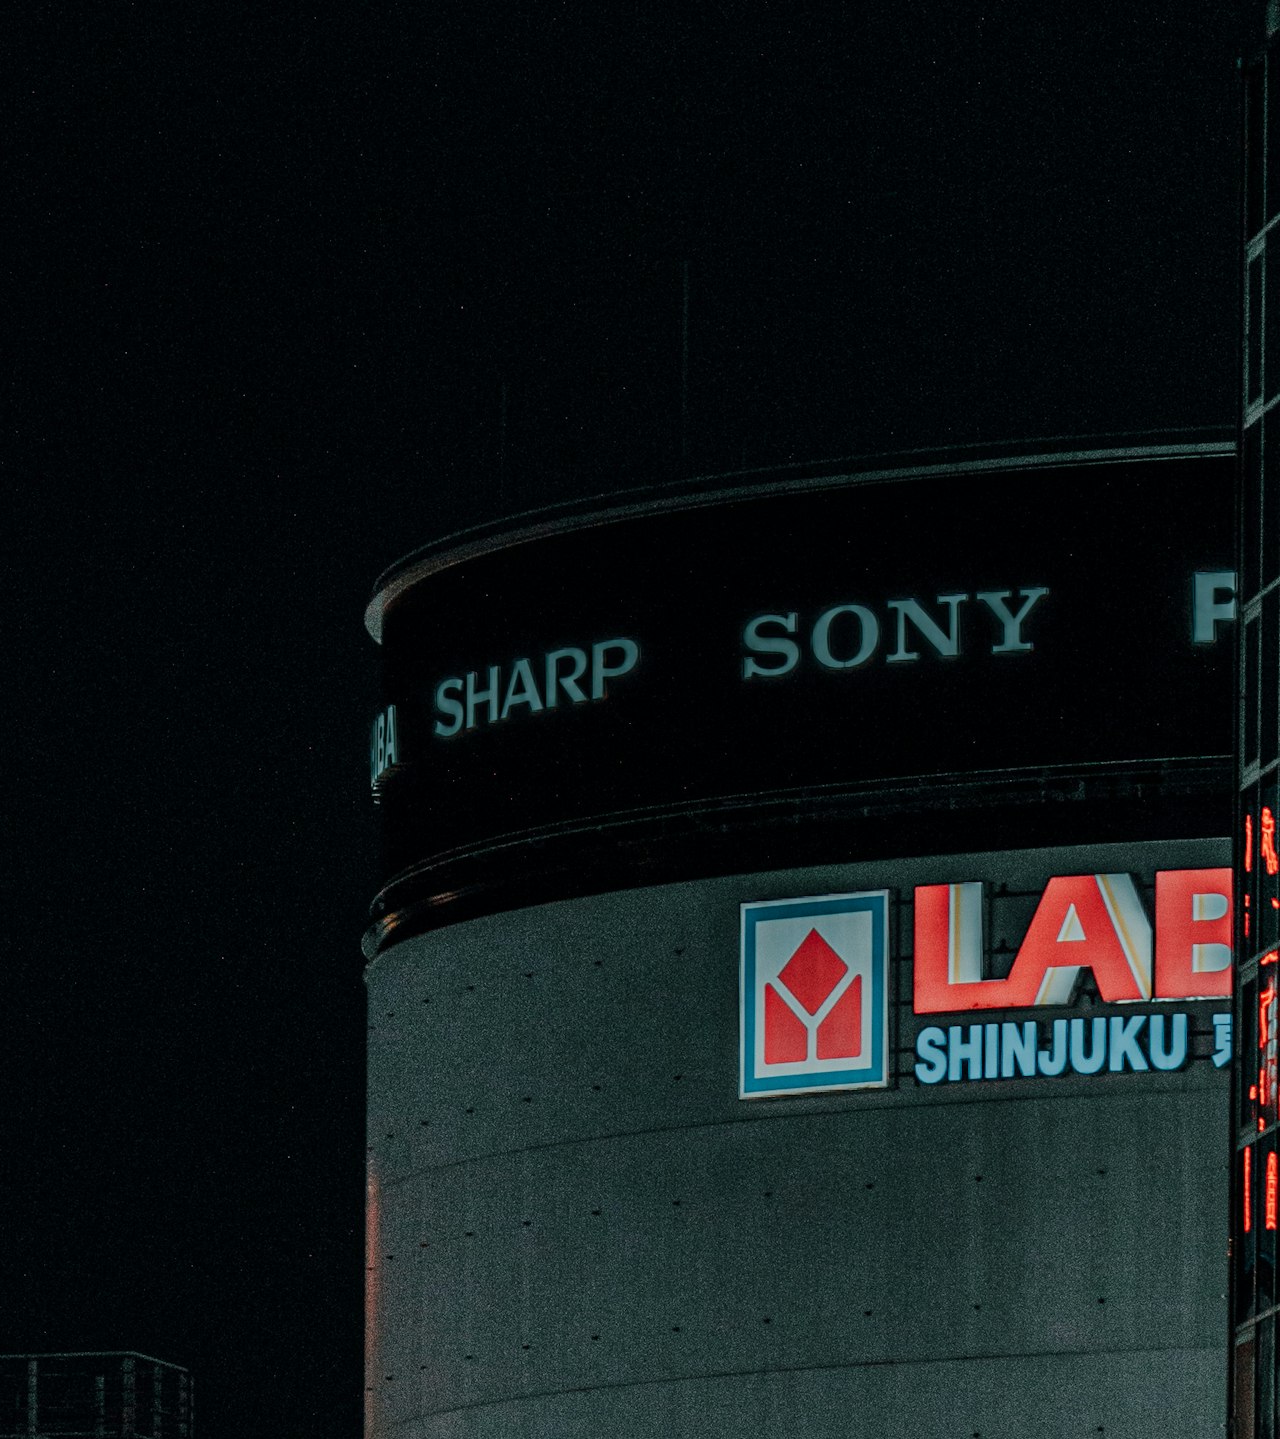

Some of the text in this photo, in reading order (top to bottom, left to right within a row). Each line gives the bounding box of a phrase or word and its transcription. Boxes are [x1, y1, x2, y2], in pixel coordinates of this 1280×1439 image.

[742, 586, 1049, 681] SONY
[434, 637, 639, 738] SHARP
[914, 1013, 1189, 1086] SHINJUKU
